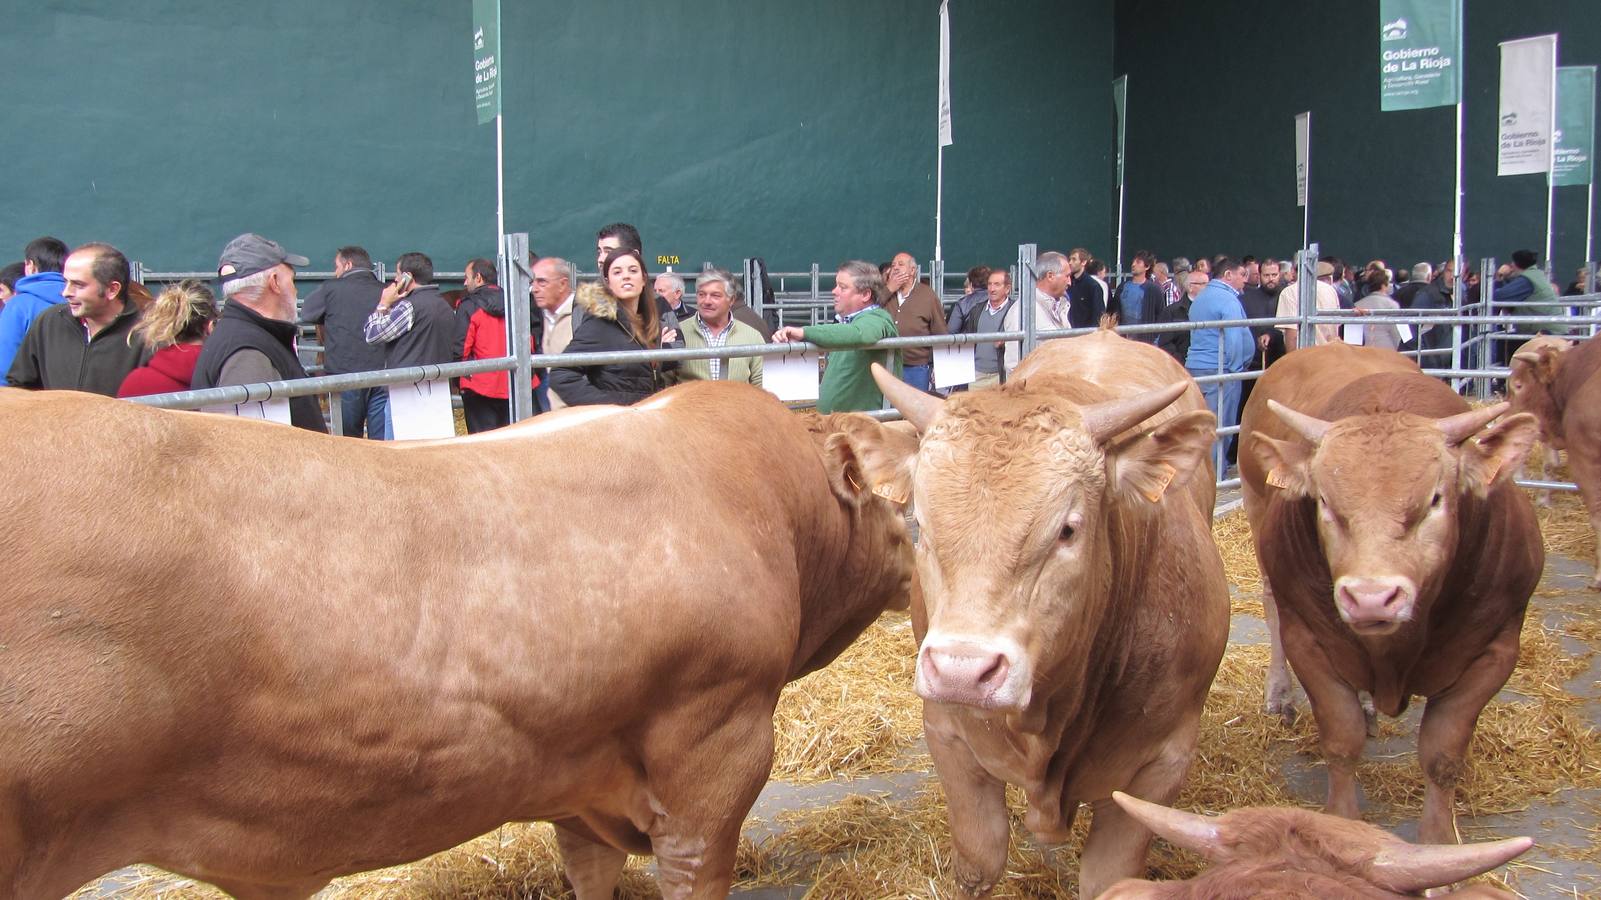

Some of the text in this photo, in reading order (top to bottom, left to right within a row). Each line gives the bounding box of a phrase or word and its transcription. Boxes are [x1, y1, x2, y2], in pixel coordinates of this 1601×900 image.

[1383, 47, 1439, 61] Gobierno
[1383, 56, 1451, 73] de La Rioja
[657, 255, 680, 265] FALTA
